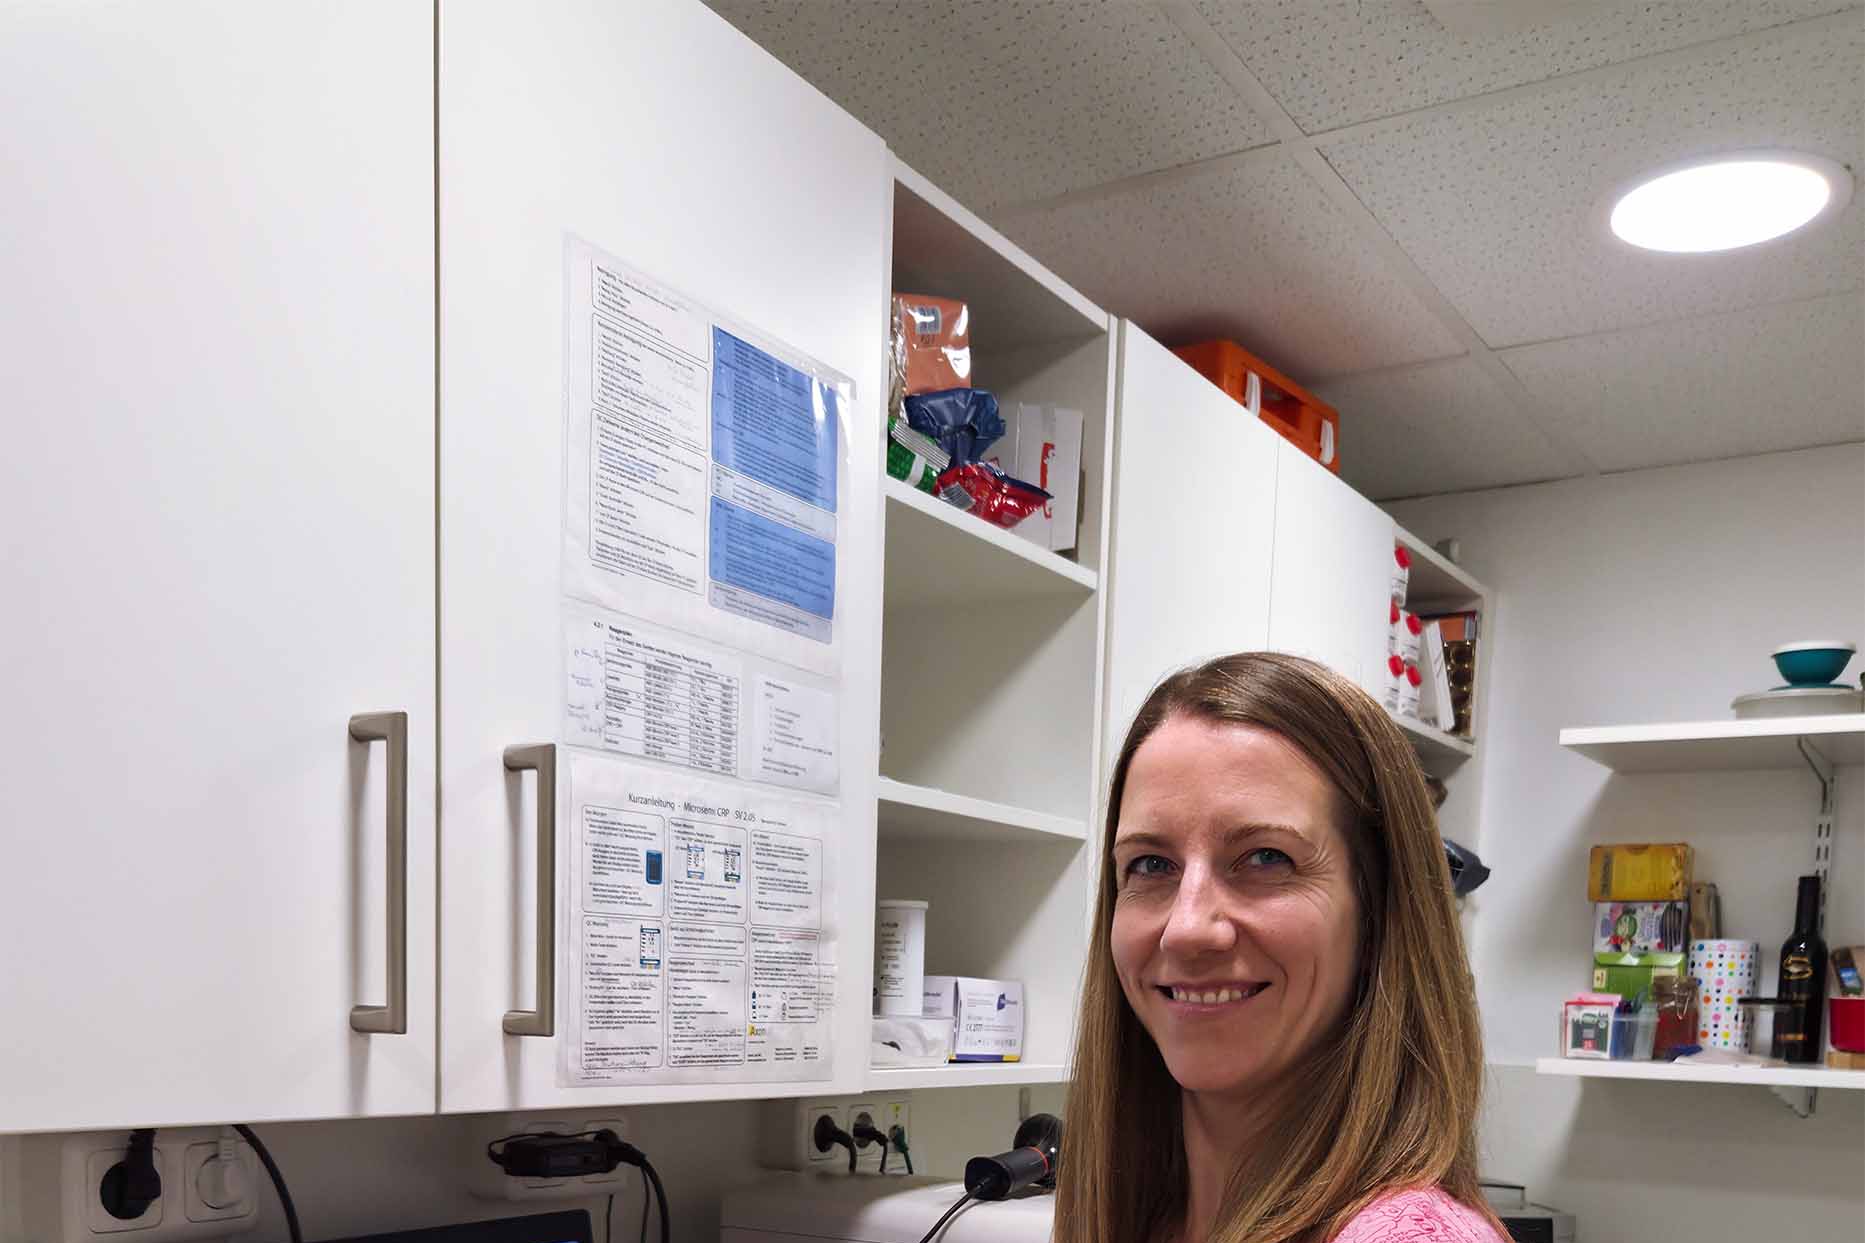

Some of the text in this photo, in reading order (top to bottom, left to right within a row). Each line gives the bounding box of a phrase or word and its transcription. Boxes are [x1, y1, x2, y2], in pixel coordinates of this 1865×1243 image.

[628, 793, 675, 811] Kurzanleitung
[684, 802, 716, 816] Microsemi
[717, 807, 730, 818] CRP
